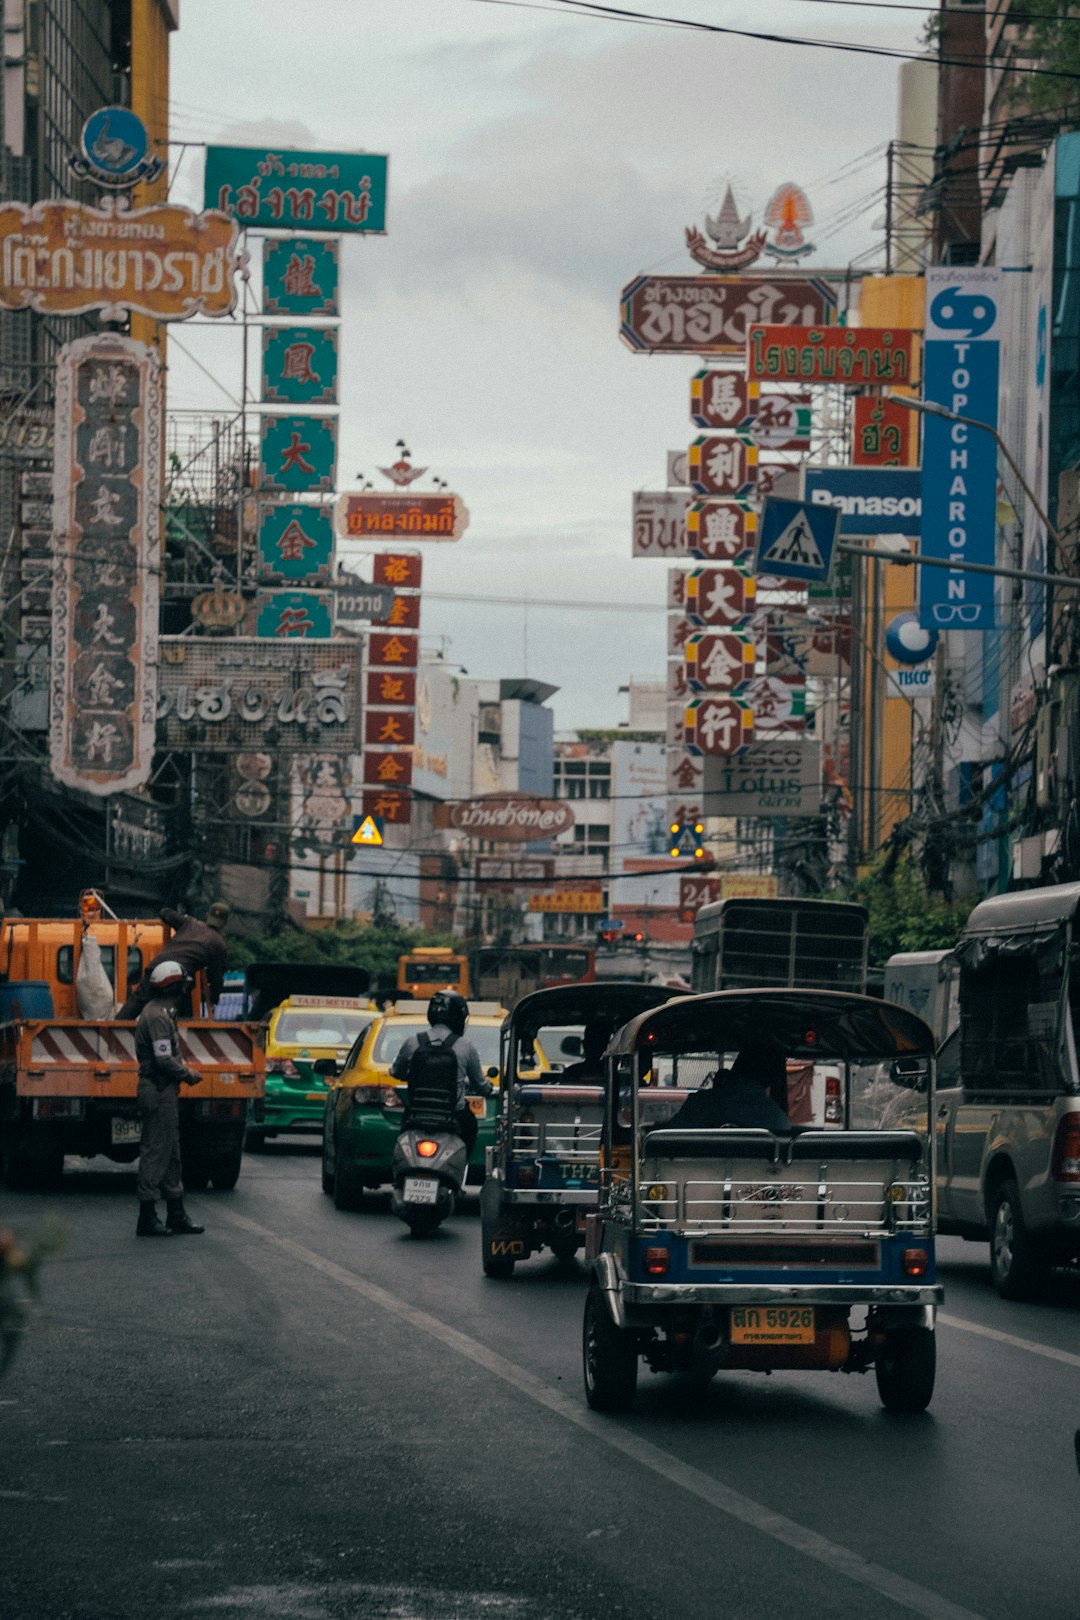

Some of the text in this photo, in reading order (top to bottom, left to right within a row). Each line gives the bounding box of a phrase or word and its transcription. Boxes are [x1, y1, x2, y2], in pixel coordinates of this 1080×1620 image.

[257, 153, 339, 178] ห้างทอง
[219, 175, 373, 223] เล่งหงษ์
[643, 282, 727, 302] ห้างทอง
[752, 331, 906, 378] โรงรับจำนำ
[898, 671, 928, 685] TISCO
[766, 1310, 812, 1328] 5926
